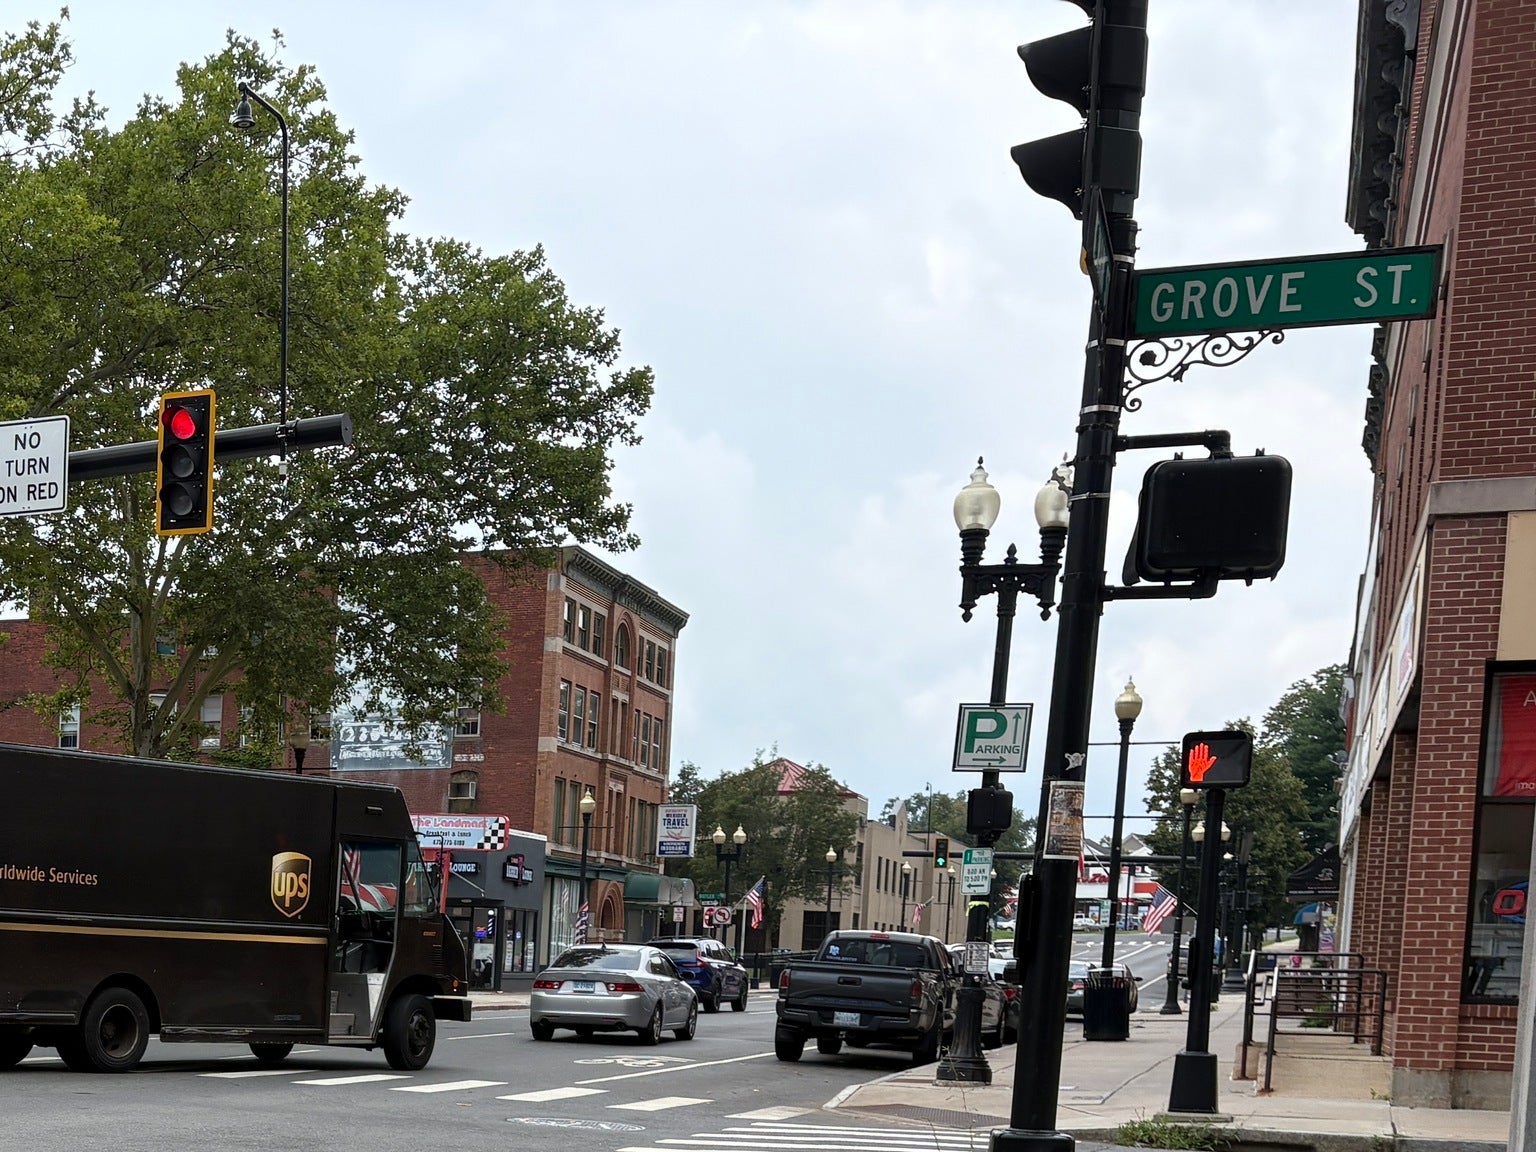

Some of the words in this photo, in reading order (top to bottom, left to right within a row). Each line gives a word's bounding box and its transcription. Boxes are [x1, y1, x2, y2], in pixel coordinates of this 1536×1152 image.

[1150, 270, 1306, 324] GROVE
[1353, 263, 1417, 309] ST.
[14, 431, 41, 451] NO
[5, 456, 49, 477] TURN
[27, 481, 58, 501] RED
[662, 818, 689, 827] TRAVEL
[49, 866, 98, 886] Services
[449, 862, 476, 872] LOUNGE
[273, 871, 309, 908] ups
